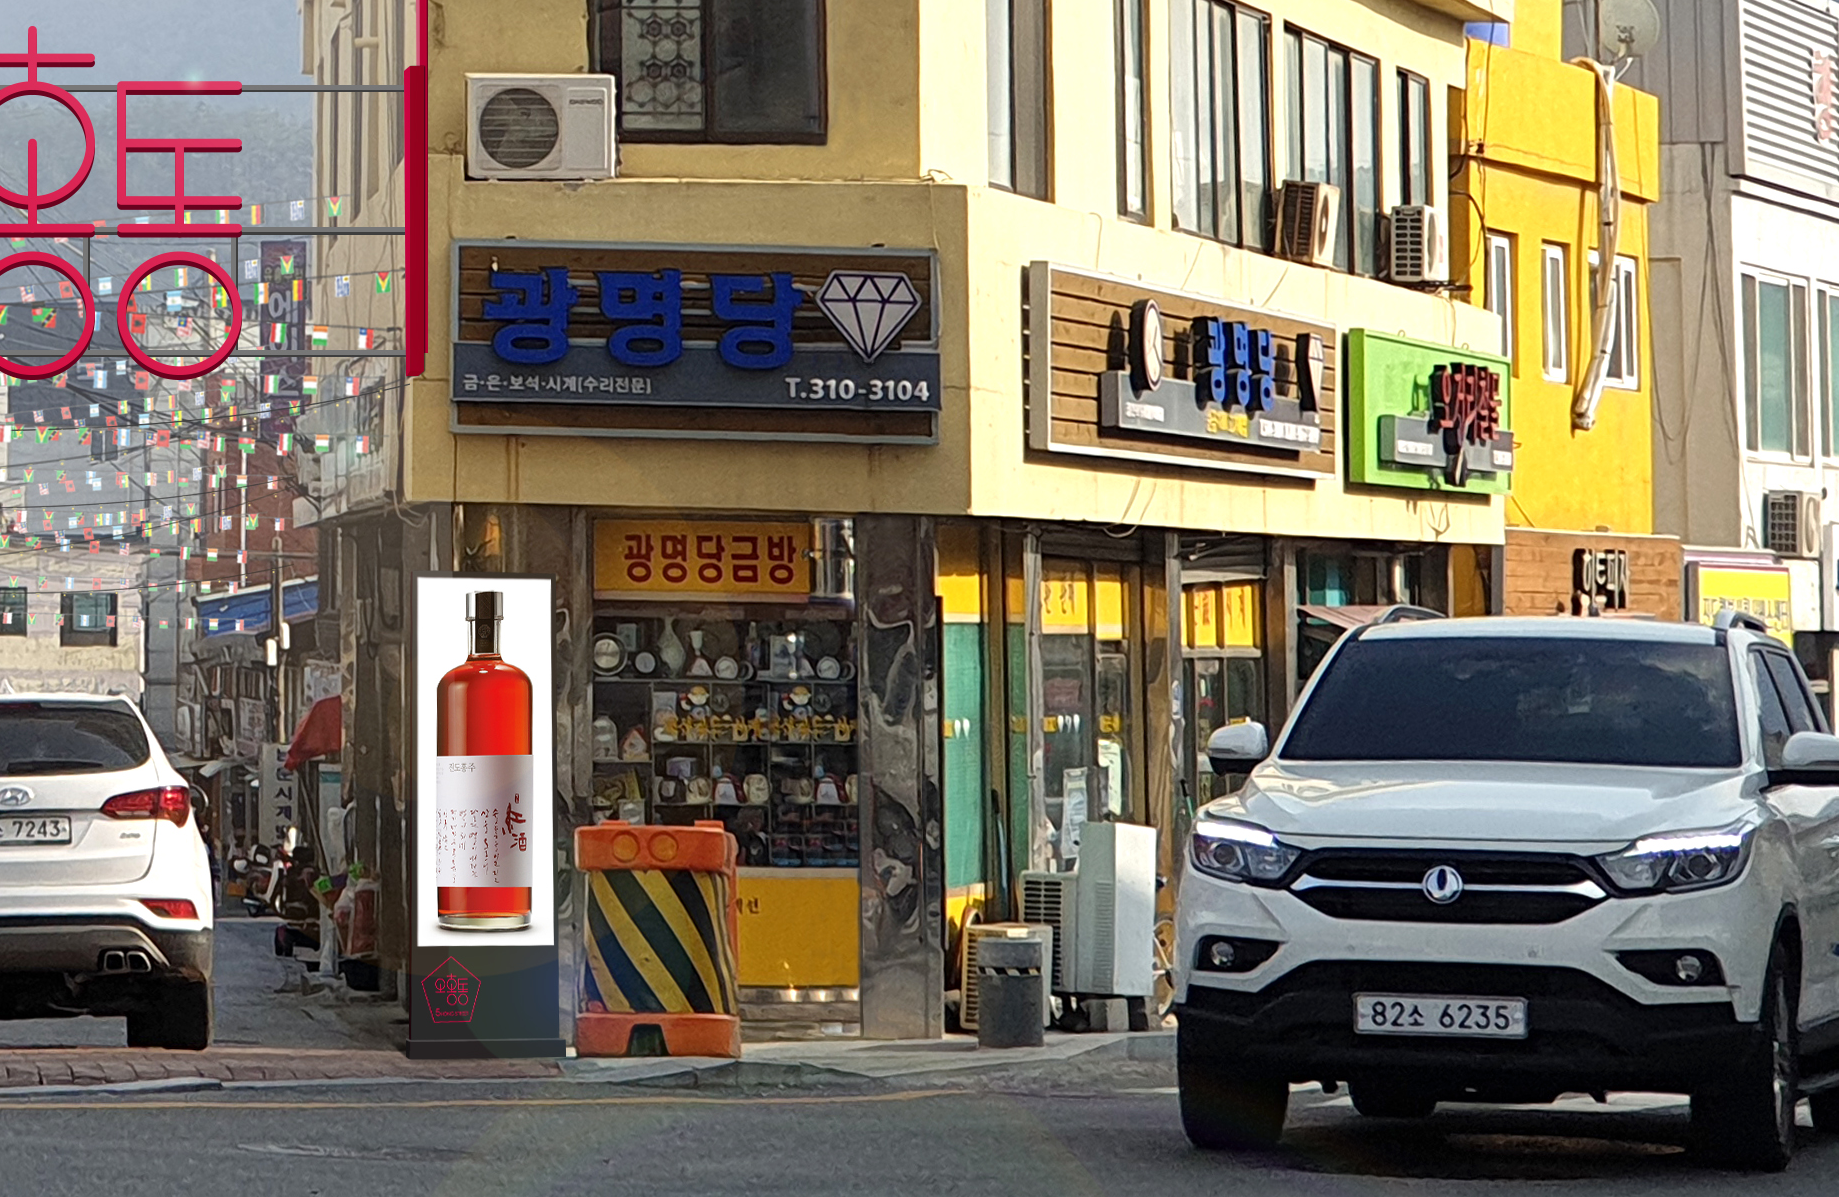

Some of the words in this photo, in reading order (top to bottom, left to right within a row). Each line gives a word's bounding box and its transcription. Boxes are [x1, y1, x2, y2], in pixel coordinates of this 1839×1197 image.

[482, 266, 804, 370] 광명당
[624, 534, 796, 585] 광명당금방
[12, 819, 62, 839] 7243
[1371, 1001, 1425, 1027] 82소
[1439, 1003, 1511, 1030] 6235
